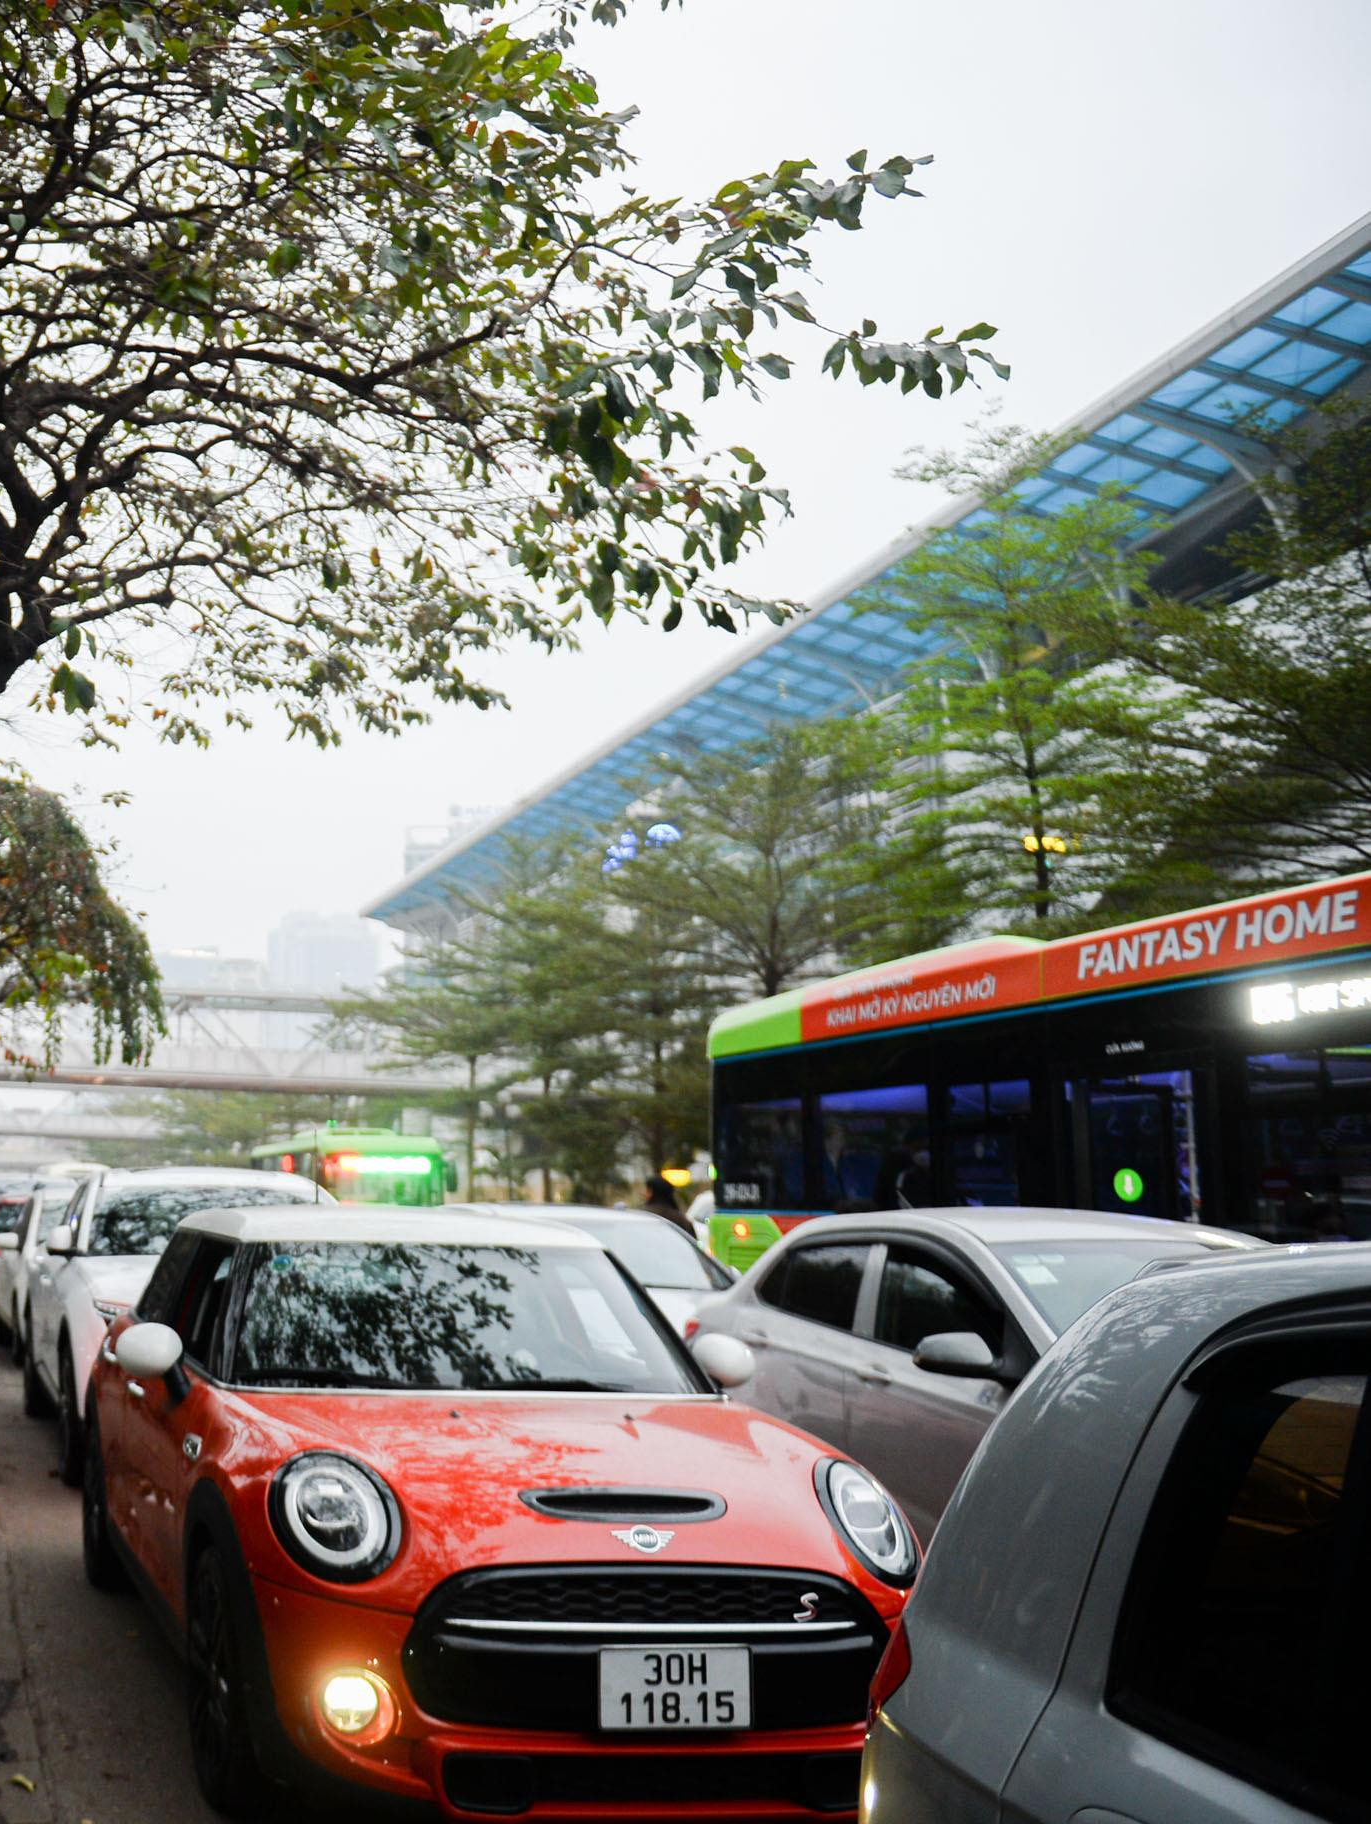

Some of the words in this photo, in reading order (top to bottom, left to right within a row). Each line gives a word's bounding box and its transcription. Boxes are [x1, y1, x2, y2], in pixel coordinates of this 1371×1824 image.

[1077, 916, 1227, 981] FANTASY
[1234, 890, 1359, 951] HOME
[793, 1592, 819, 1623] S
[644, 1653, 707, 1686] 30H
[621, 1691, 735, 1724] 118.15
